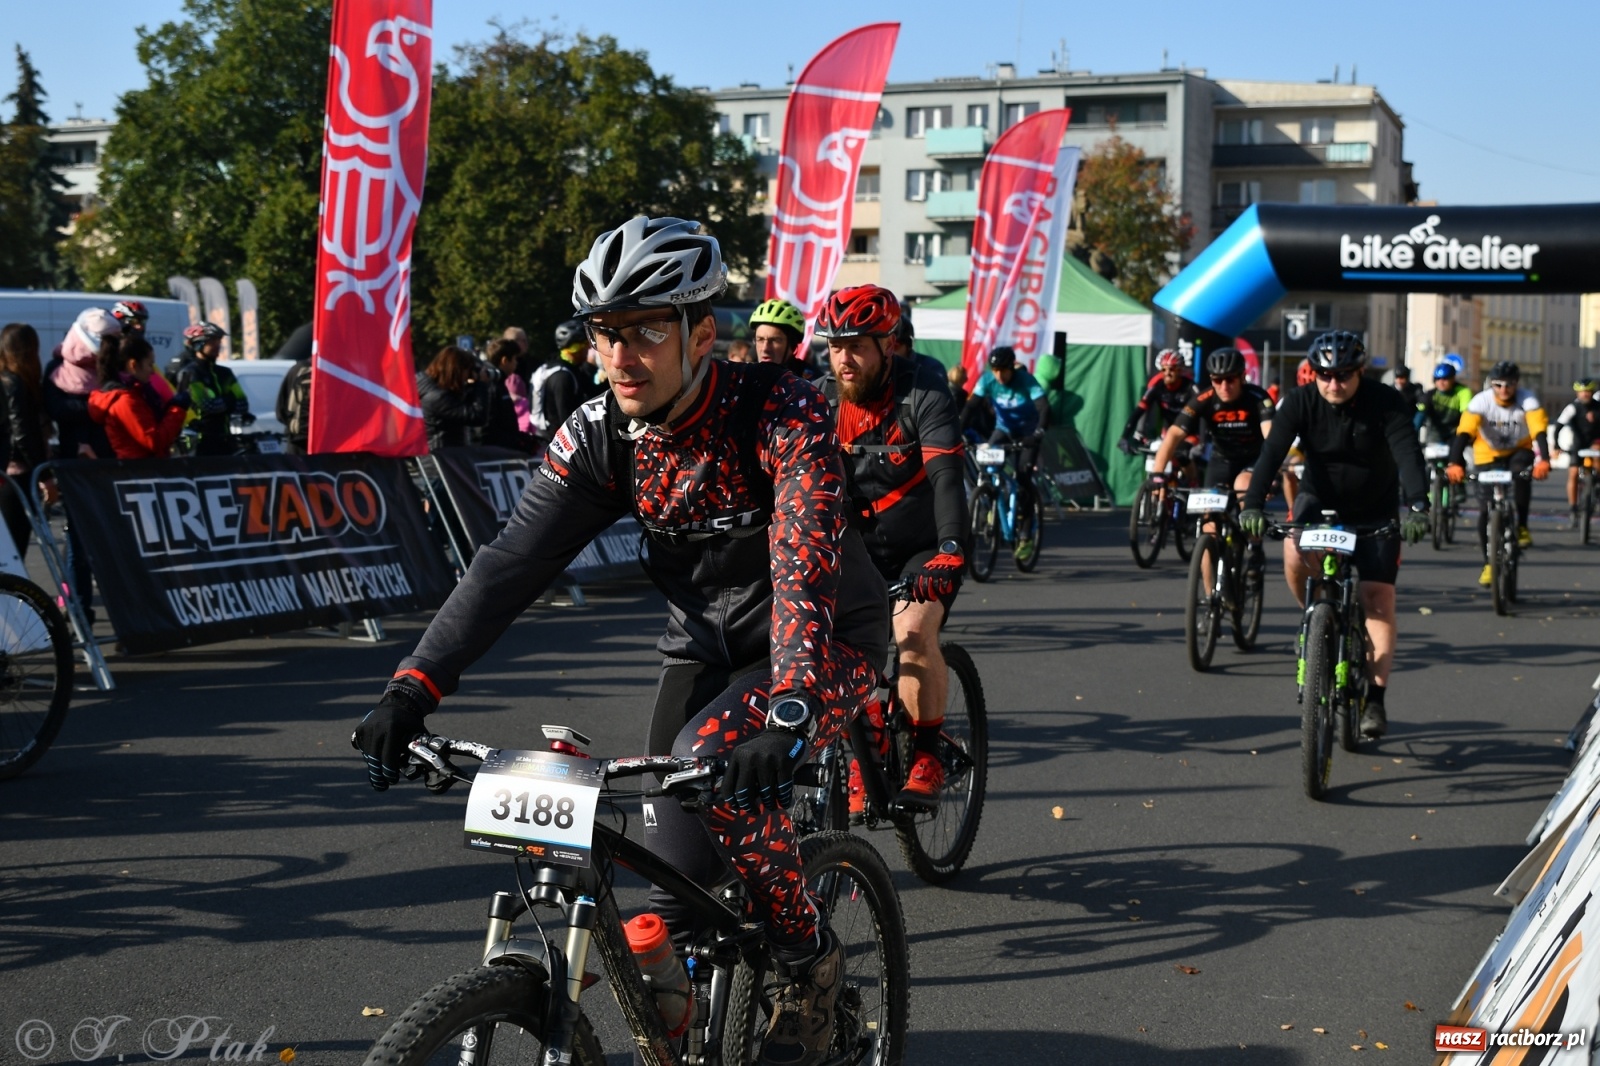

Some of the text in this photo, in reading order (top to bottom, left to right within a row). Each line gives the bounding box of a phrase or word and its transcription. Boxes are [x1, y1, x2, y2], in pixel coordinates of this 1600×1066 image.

[1340, 234, 1540, 270] bike atelier
[1011, 177, 1057, 374] RACIBÓR
[670, 284, 709, 301] RUDY
[150, 336, 172, 349] szy
[1212, 410, 1249, 422] CST
[117, 473, 384, 552] TREZADO
[1312, 533, 1347, 545] 3189
[166, 562, 412, 627] USZCZELNIAMY NAJLEPSZYCH
[491, 788, 575, 830] 3188
[526, 845, 545, 853] CST
